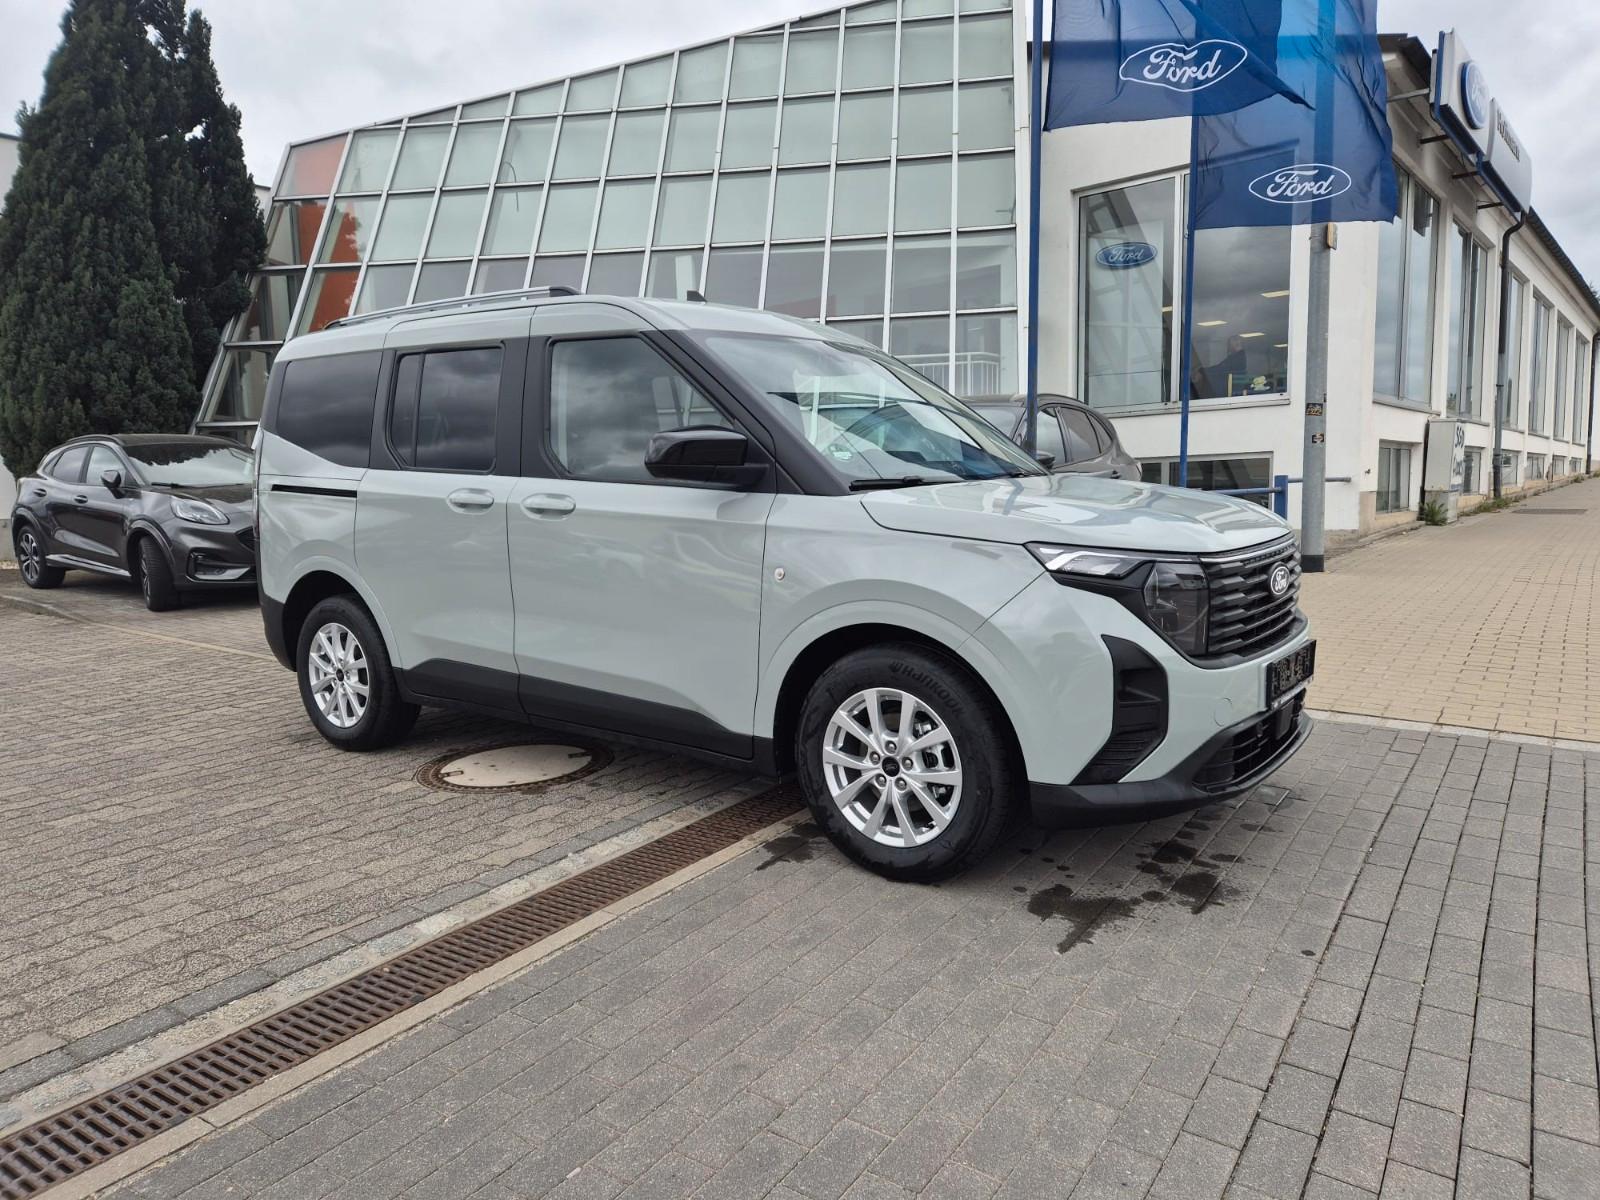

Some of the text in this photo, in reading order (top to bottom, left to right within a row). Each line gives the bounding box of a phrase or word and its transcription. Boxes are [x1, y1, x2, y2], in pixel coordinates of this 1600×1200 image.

[1142, 48, 1221, 83] Ford
[1266, 169, 1334, 198] Ford
[1109, 246, 1144, 262] Ford
